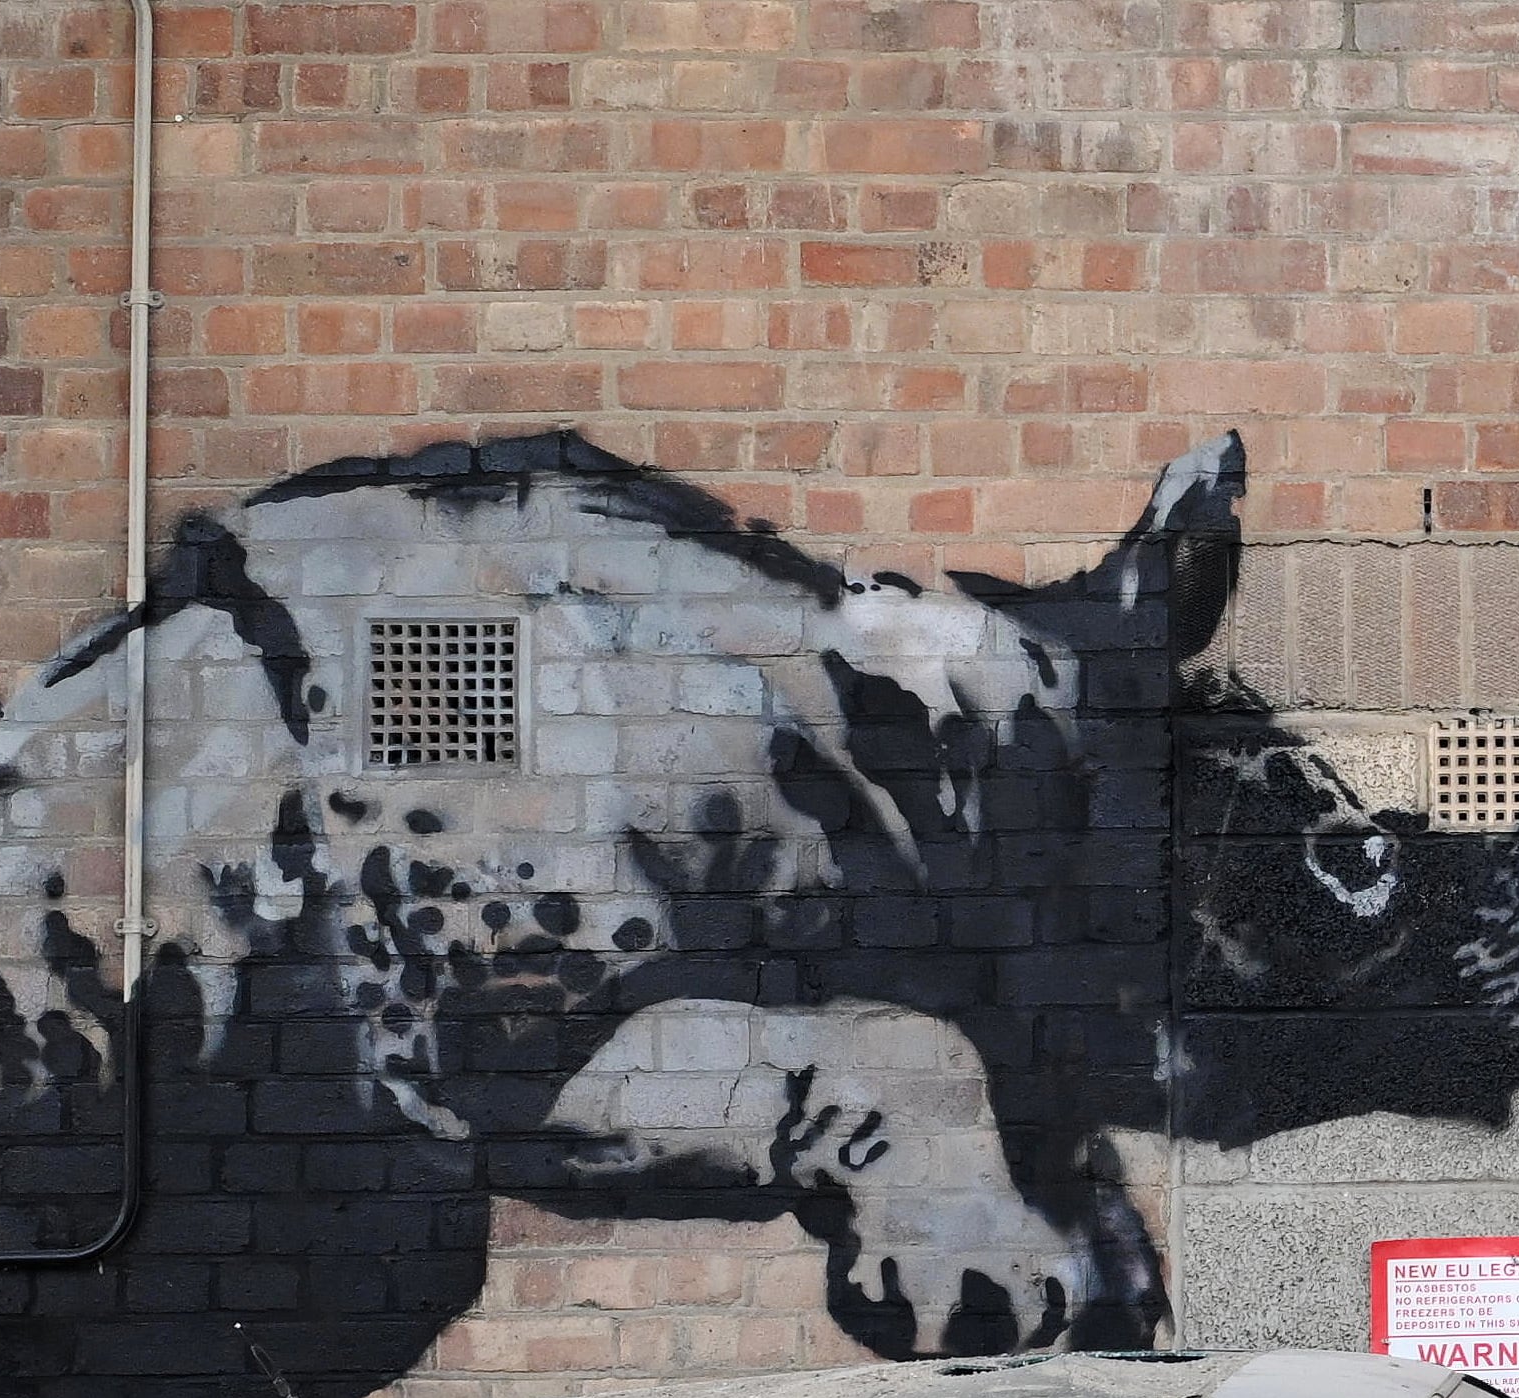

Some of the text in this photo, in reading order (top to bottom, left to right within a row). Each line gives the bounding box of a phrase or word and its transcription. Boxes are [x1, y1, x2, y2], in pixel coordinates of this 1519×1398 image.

[1394, 1264, 1437, 1279] NEW
[1445, 1263, 1470, 1278] EU
[1395, 1283, 1477, 1294] NO ASBESTOS
[1395, 1297, 1412, 1306] NO
[1416, 1295, 1512, 1305] REFRIGERATORS
[1395, 1307, 1493, 1319] FREEZERS TO BE
[1395, 1320, 1461, 1330] DEPOSITED
[1464, 1319, 1476, 1329] IN
[1479, 1319, 1505, 1328] THIS
